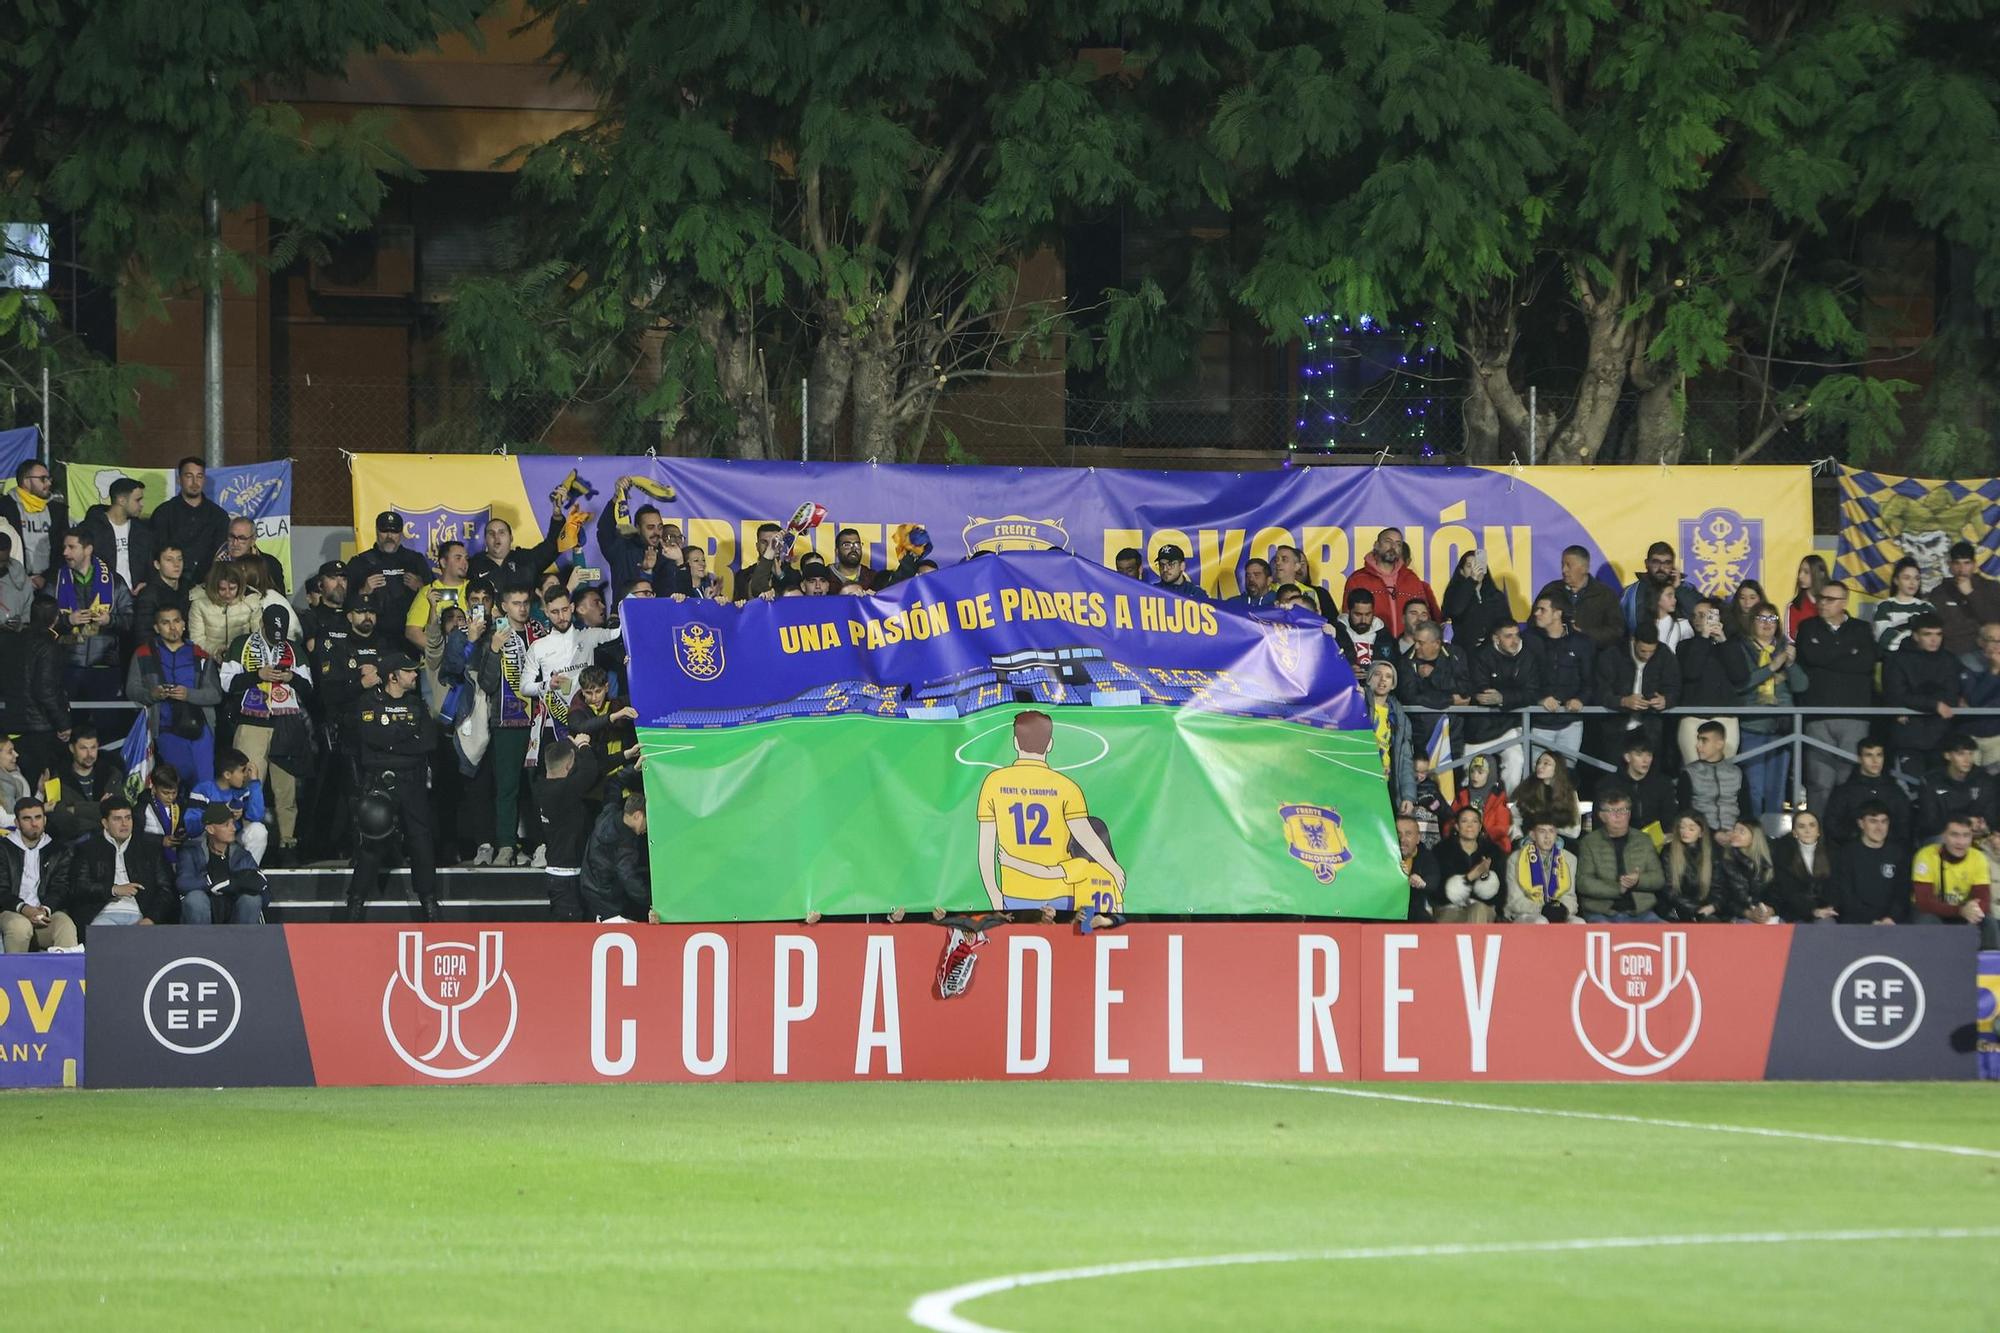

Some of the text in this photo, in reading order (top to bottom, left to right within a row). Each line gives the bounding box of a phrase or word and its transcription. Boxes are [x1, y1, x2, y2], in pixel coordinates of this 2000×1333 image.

[994, 525, 1037, 536] FRENTE
[779, 587, 1219, 654] UNA PASIÓN DE PADRES A HIJOS
[1000, 786, 1019, 795] FRENTE
[1008, 802, 1052, 845] 12
[1091, 891, 1114, 914] 12
[434, 955, 467, 976] COPA
[1621, 955, 1653, 976] COPA
[441, 981, 461, 998] REY
[1627, 980, 1647, 997] REY
[590, 932, 1503, 1077] COPA DEL REY
